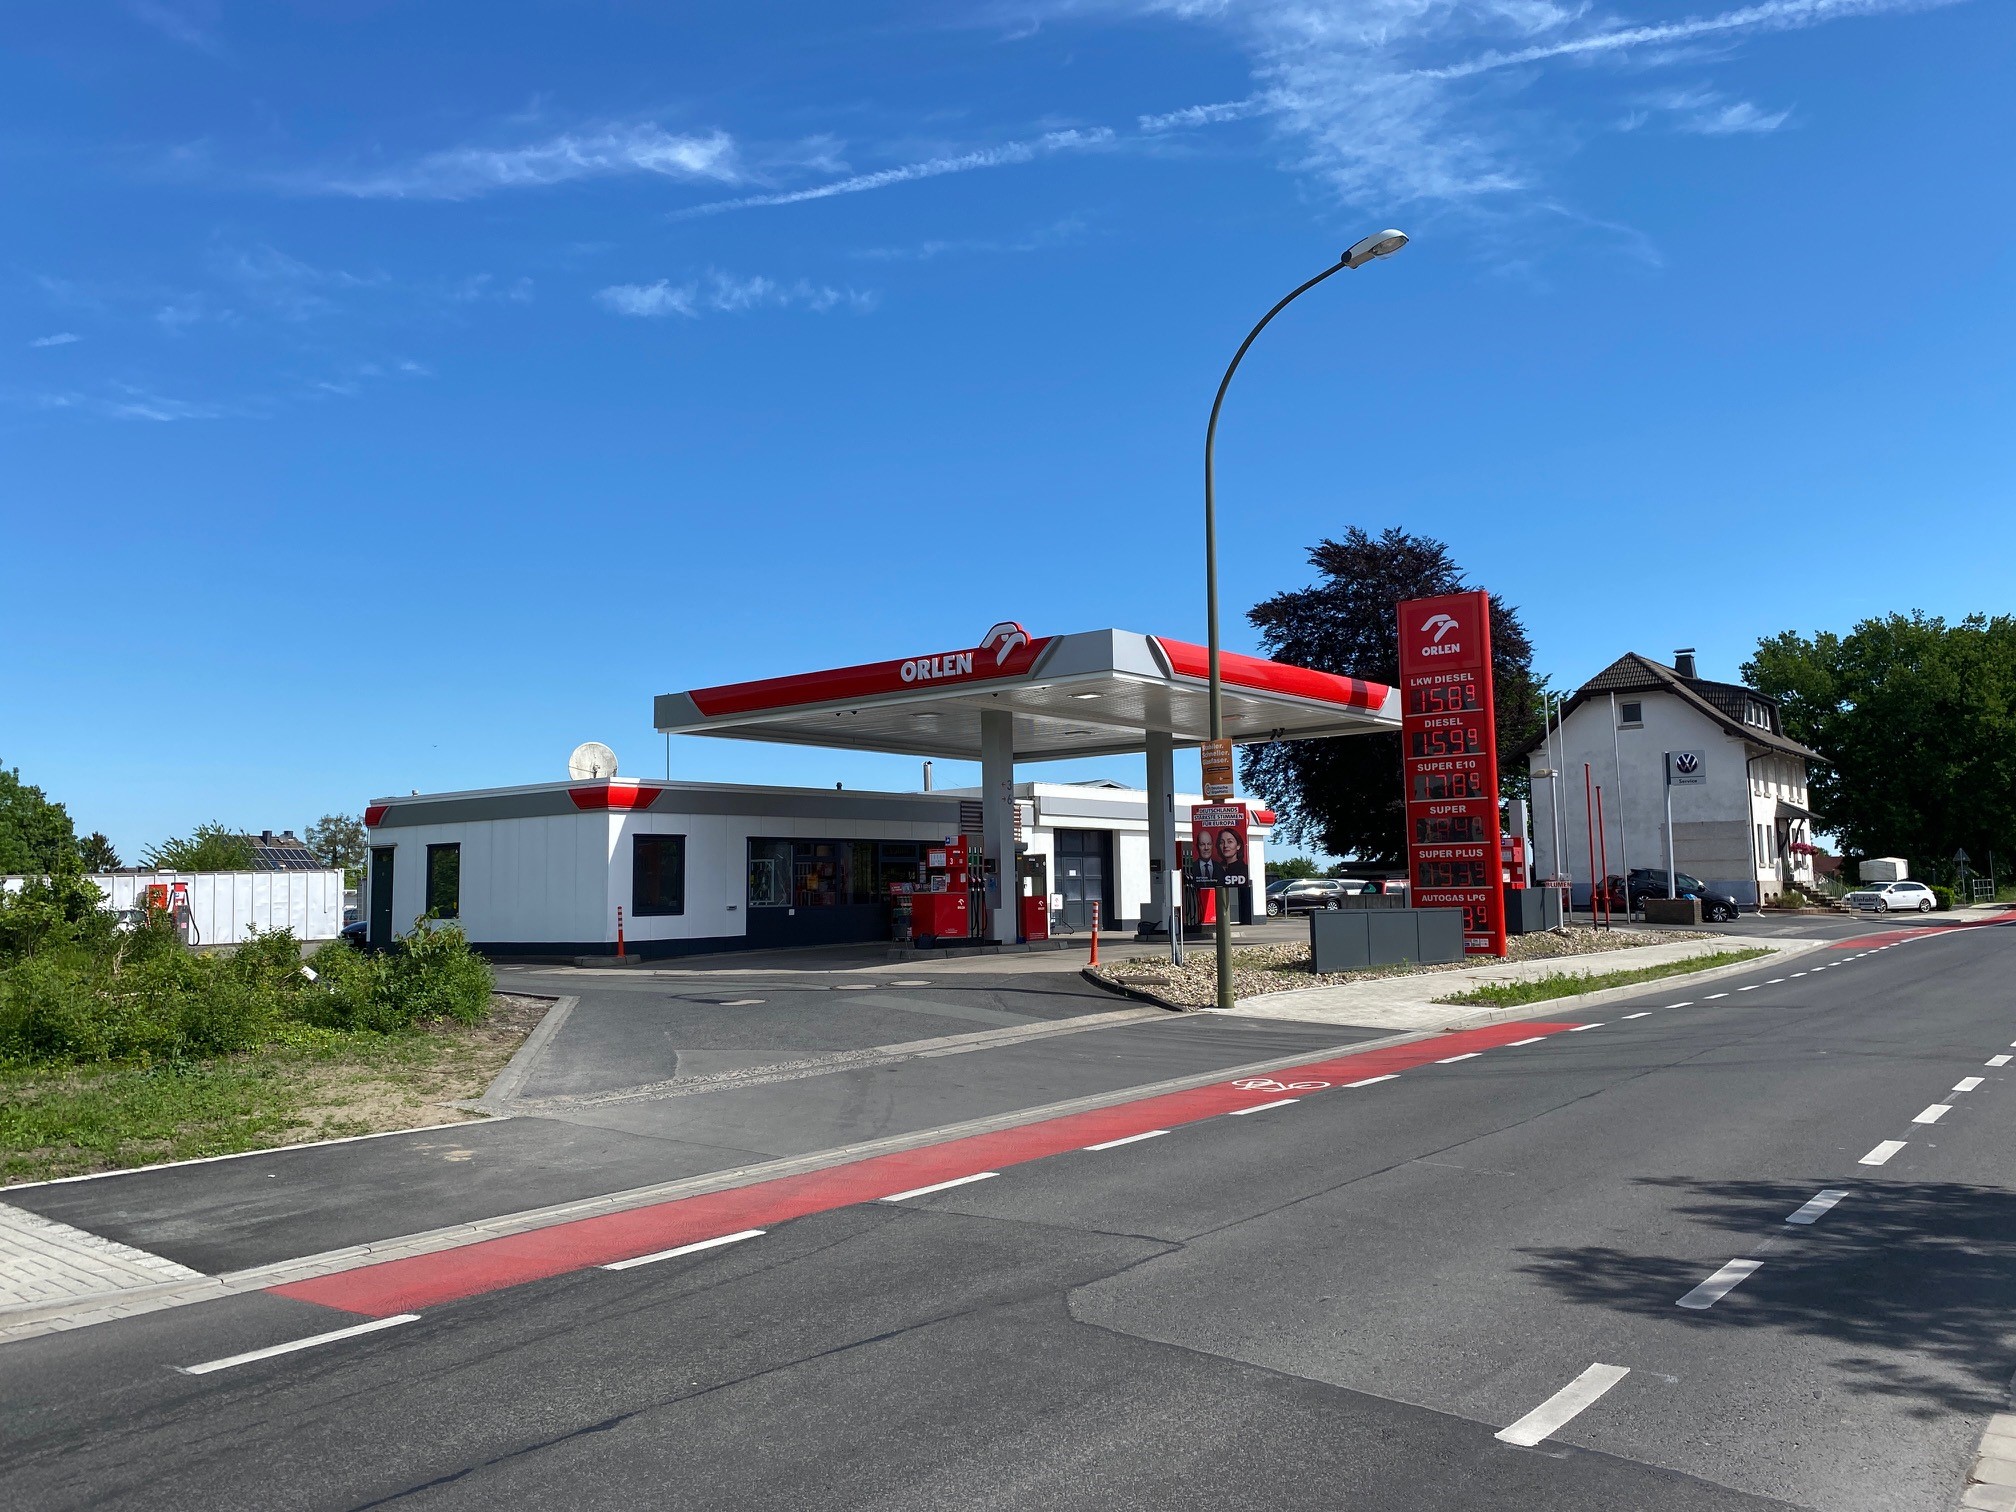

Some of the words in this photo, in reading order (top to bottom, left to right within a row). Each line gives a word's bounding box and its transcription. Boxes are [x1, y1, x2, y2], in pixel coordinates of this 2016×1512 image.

[1422, 643, 1460, 657] ORLEN
[901, 652, 973, 682] ORLEN
[1410, 677, 1432, 686] LKW
[1435, 673, 1474, 684] DIESEL
[1425, 718, 1463, 728] DIESEL
[1417, 762, 1453, 771] SUPER
[1456, 760, 1476, 769] E10
[1007, 794, 1012, 805] 6
[1166, 794, 1172, 813] 1
[1430, 805, 1466, 814] SUPER
[1419, 850, 1453, 858] SUPER
[1456, 849, 1483, 857] PLUS
[1225, 875, 1246, 885] SPD
[1422, 894, 1464, 902] AUTOGAS
